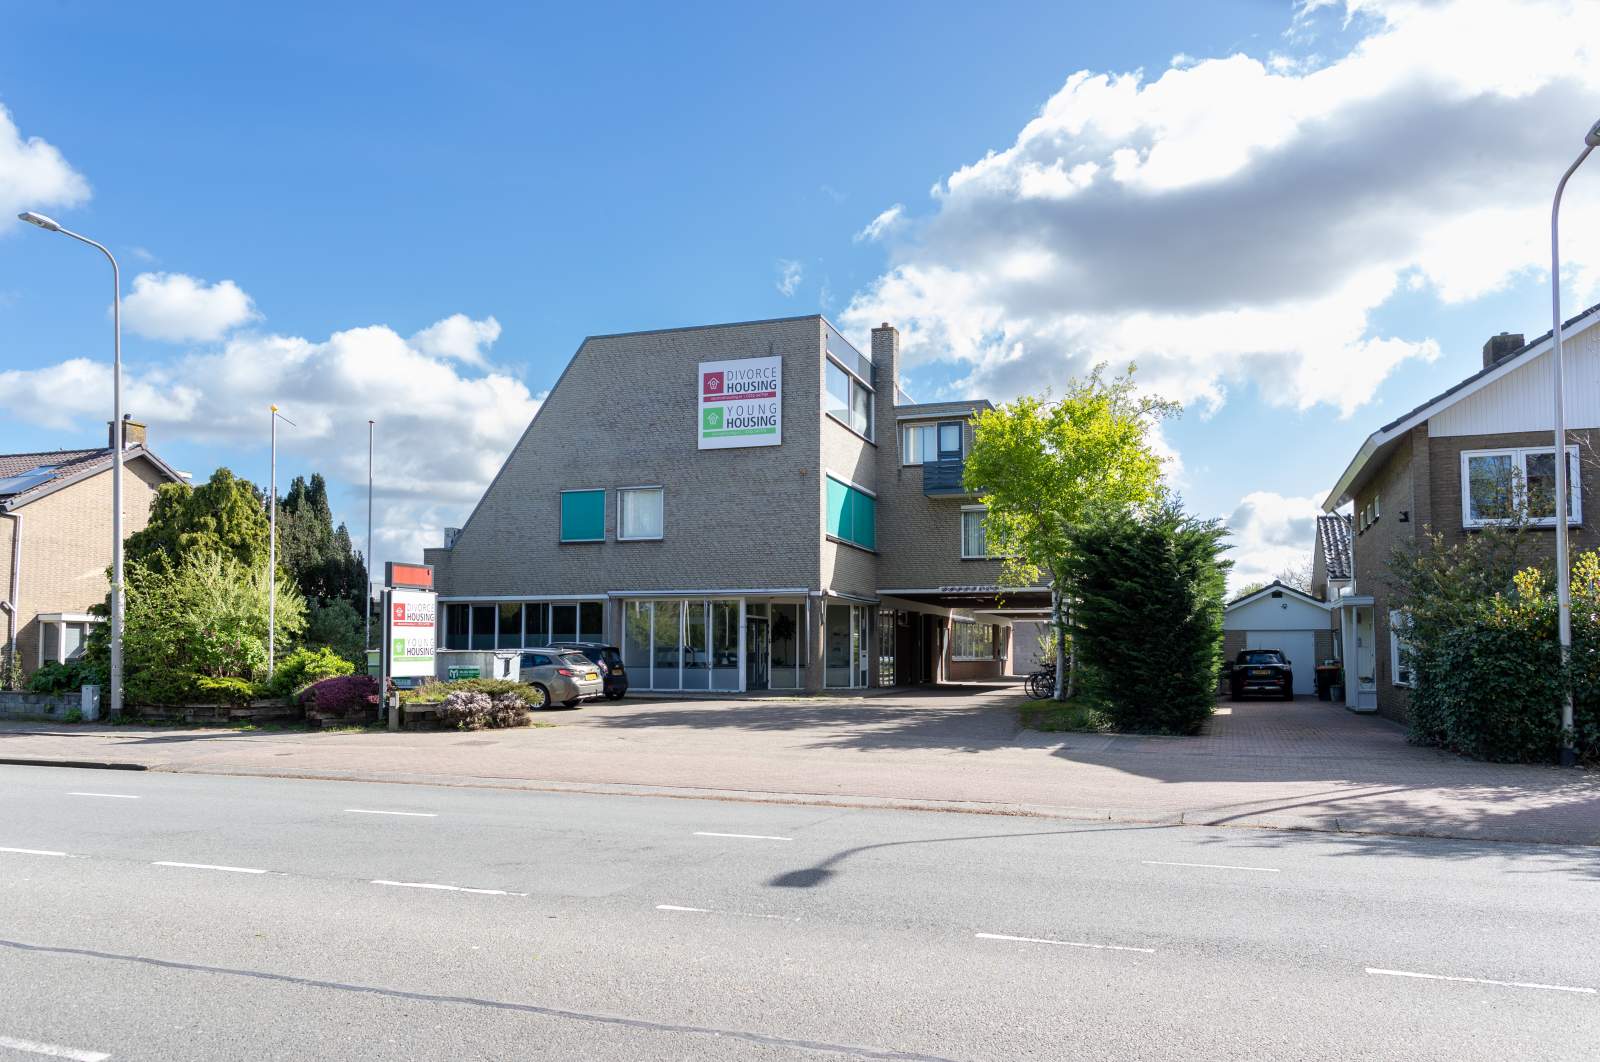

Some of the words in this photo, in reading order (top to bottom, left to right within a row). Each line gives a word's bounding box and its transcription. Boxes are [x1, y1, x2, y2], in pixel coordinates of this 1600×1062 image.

[727, 367, 777, 381] DIVORCE
[727, 380, 777, 393] HOUSING
[727, 403, 777, 417] YOUNG
[726, 415, 777, 428] HOUSING
[407, 603, 434, 612] DIVORCE
[407, 612, 435, 621] HOUSING
[407, 638, 434, 647] YOUNG
[406, 647, 434, 656] HOUSING
